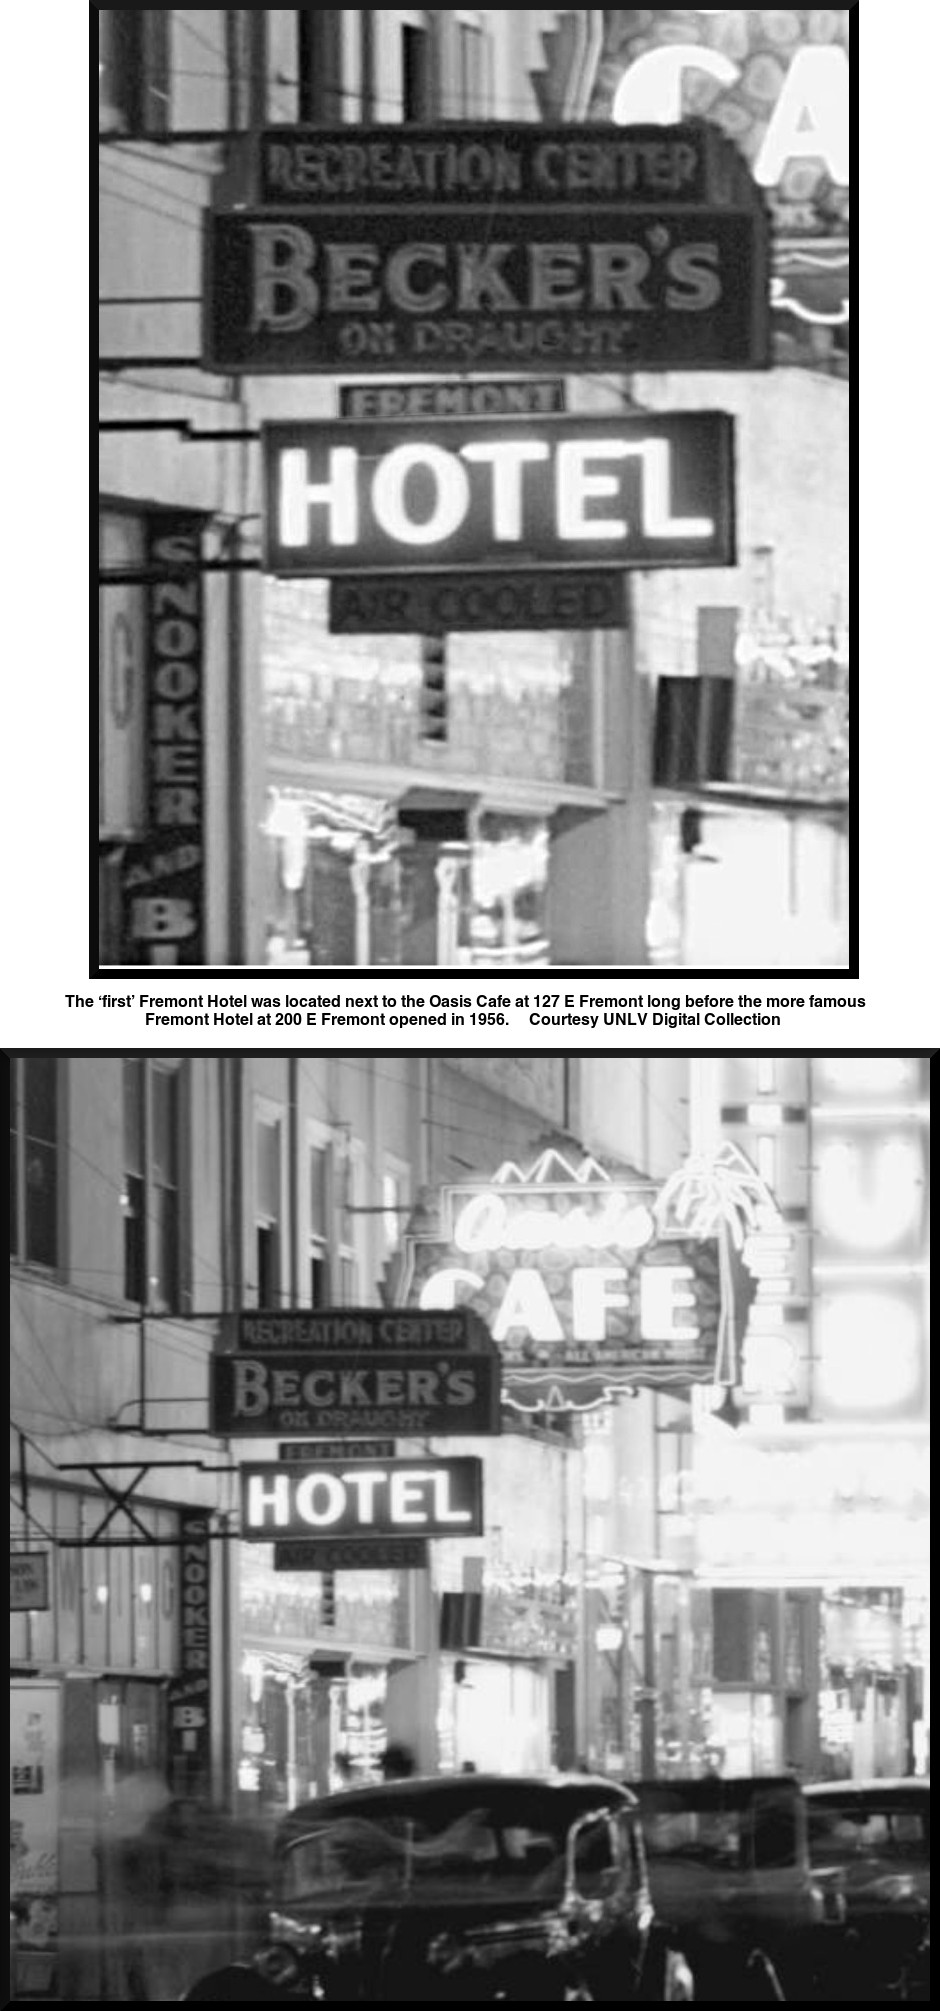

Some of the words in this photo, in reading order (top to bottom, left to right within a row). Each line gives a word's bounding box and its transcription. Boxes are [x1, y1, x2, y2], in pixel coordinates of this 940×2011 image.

[267, 142, 521, 191] RECREATION
[533, 141, 697, 190] CENTER
[246, 222, 722, 332] BECKER'S
[339, 321, 396, 354] ON
[351, 383, 556, 415] FREMONT
[278, 437, 714, 547] HOTEL
[334, 587, 411, 624] AIR
[431, 584, 614, 623] COOLED
[152, 534, 199, 824] SNOOKER
[124, 843, 200, 888] AND
[243, 1318, 373, 1344] RECREATION
[378, 1317, 464, 1343] CENTER
[419, 1265, 700, 1342] CAFE
[231, 1359, 477, 1418] BECKER'S
[248, 1470, 472, 1527] HOTEL
[183, 1517, 208, 1670] SNOOKER
